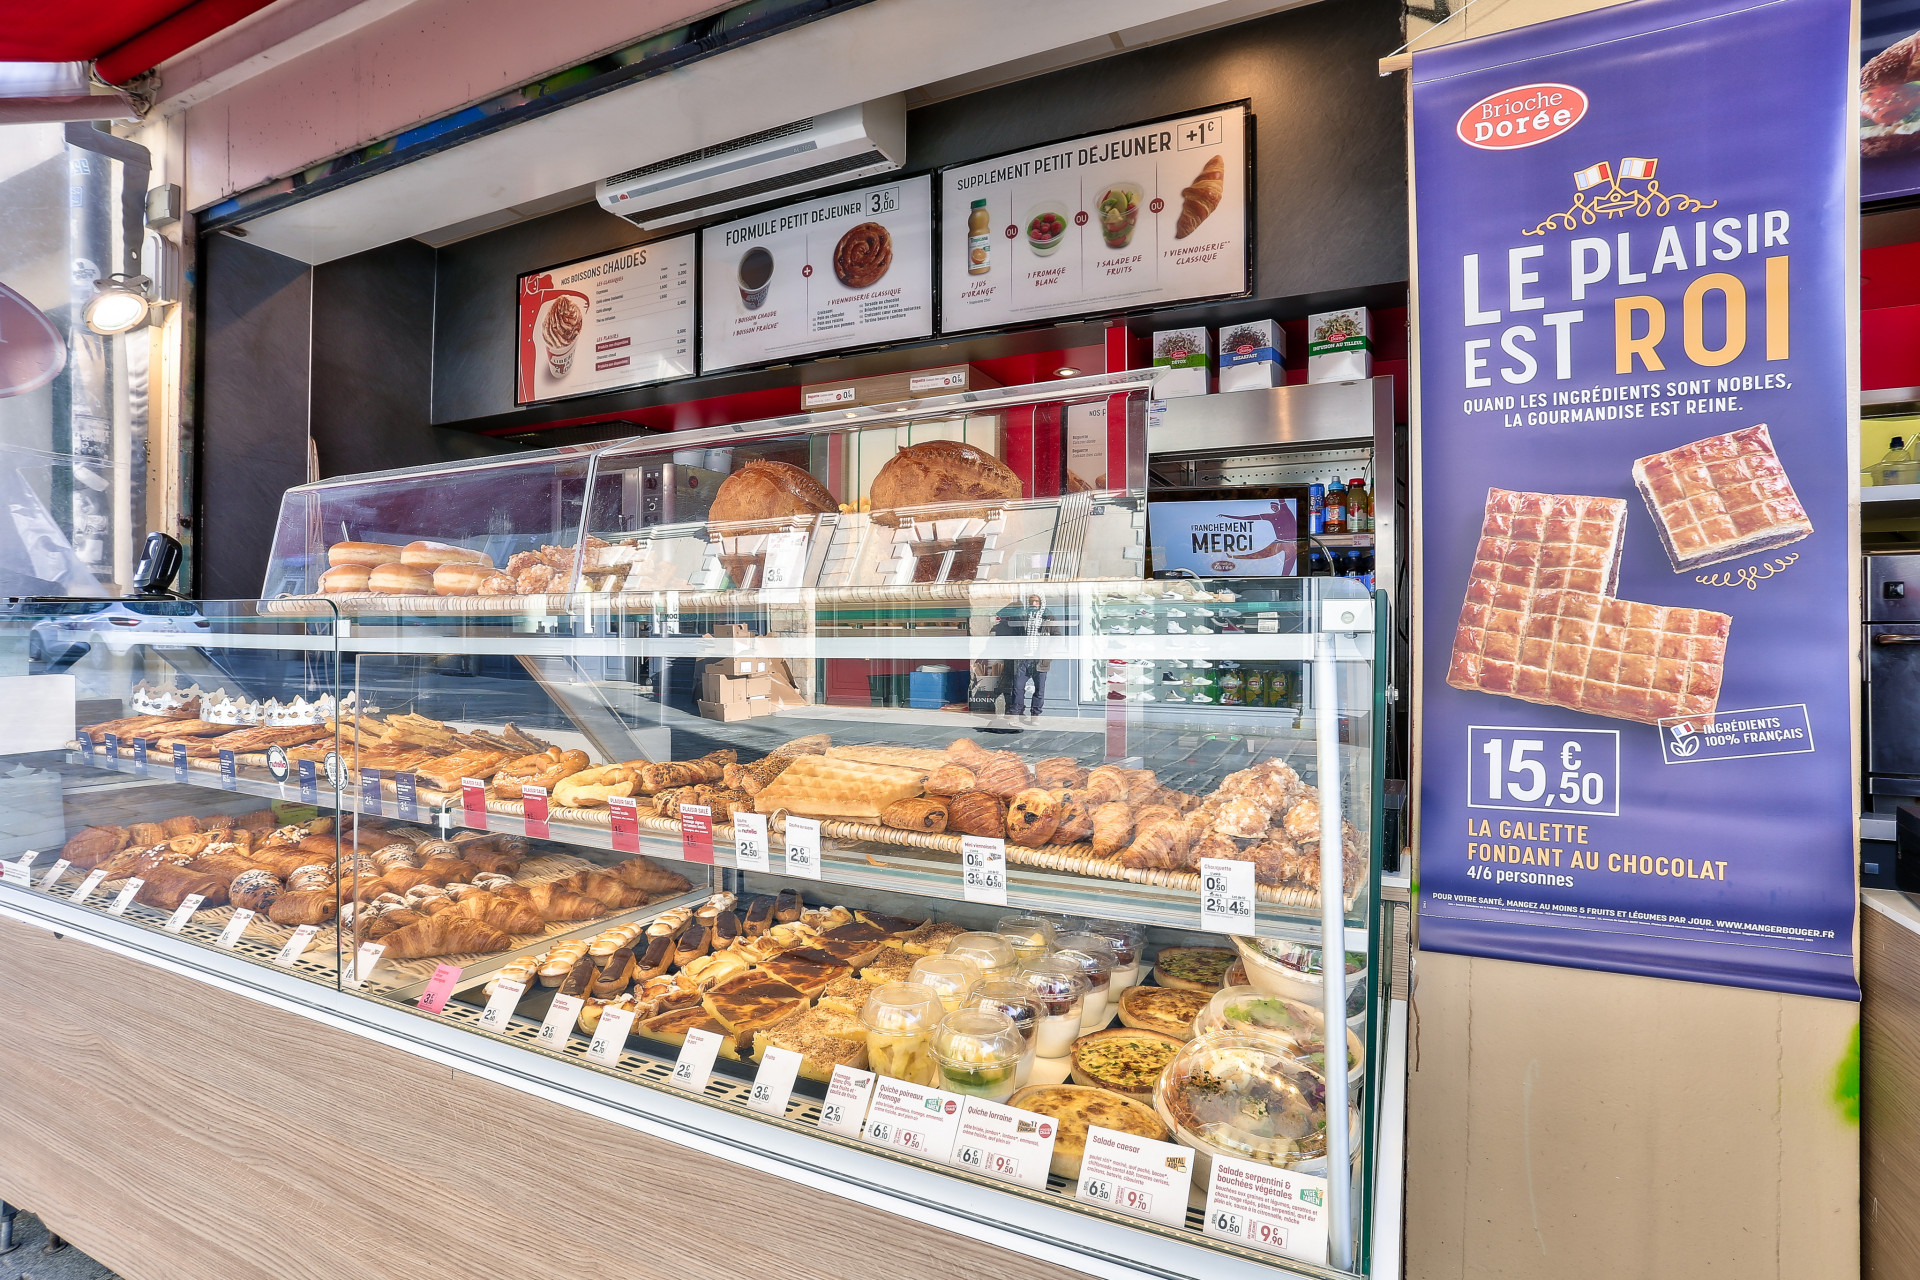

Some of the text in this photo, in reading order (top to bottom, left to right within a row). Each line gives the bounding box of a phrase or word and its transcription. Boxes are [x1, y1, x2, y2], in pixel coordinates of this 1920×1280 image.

[1481, 90, 1563, 121] Brioche
[1474, 106, 1573, 142] Dorée
[1186, 123, 1205, 146] +1
[957, 131, 1171, 190] SUPPLÉMENT PETIT DÉJEUNER
[1151, 201, 1162, 211] OU
[726, 202, 861, 246] FORMULE PETIT DÉJEUNER
[1076, 214, 1087, 223] OU
[1006, 228, 1017, 237] OU
[561, 250, 647, 286] NOS BOISSONS CHAUDES
[1102, 256, 1129, 268] SALADE
[1132, 254, 1142, 263] DE
[1176, 253, 1218, 266] CLASSIQUE
[1463, 209, 1790, 327] LE PLAISIR
[1032, 266, 1066, 279] FROMAGE
[1106, 266, 1132, 276] FRUITS
[603, 276, 623, 286] CLASSIQUES
[975, 280, 987, 290] JUS
[1035, 277, 1058, 287] BLANC
[831, 288, 901, 306] VIENNOISERIE CLASSIQUE
[738, 311, 777, 324] BOISSON CHAUDE
[1464, 255, 1790, 389] EST ROI
[735, 326, 755, 336] BOISSON
[1463, 372, 1793, 415] QUAND LES INGRÉDIENTS SONT NOBLES,
[1504, 396, 1744, 428] LA GOURMANDISE EST REINE.
[1191, 521, 1254, 532] FRANCHEMENT
[1192, 534, 1252, 554] MERCI
[1703, 717, 1780, 735] INGRÉDIENTS
[1705, 727, 1804, 747] 100% FRANÇAIS
[1560, 740, 1582, 771] €
[1467, 818, 1589, 845] LA GALETTE
[1467, 843, 1728, 881] FONDANT AU CHOCOLAT
[1466, 866, 1574, 888] 4/6 personnes
[1432, 892, 1452, 901] POUR
[1454, 895, 1477, 903] VOTRE
[1479, 897, 1504, 906] SANTÉ,
[1506, 900, 1538, 910] MANGEZ
[1552, 904, 1578, 913] MOINS
[1587, 908, 1615, 917] FRUITS
[1629, 911, 1667, 921] LÉGUMES
[1669, 915, 1686, 924] PAR
[1688, 917, 1714, 927] JOUR.
[1716, 920, 1834, 939] WWW.MANGERBOUGER.FR
[878, 1092, 900, 1104] fromage
[880, 1084, 924, 1101] Quiche poireaux
[968, 1106, 1013, 1122] Quiche lorraine
[1093, 1135, 1140, 1154] Salade caesar
[1218, 1164, 1244, 1178] Salade
[1245, 1172, 1284, 1186] serpentini
[1215, 1184, 1237, 1194] bouchées
[1217, 1173, 1292, 1200] bouchées végétales
